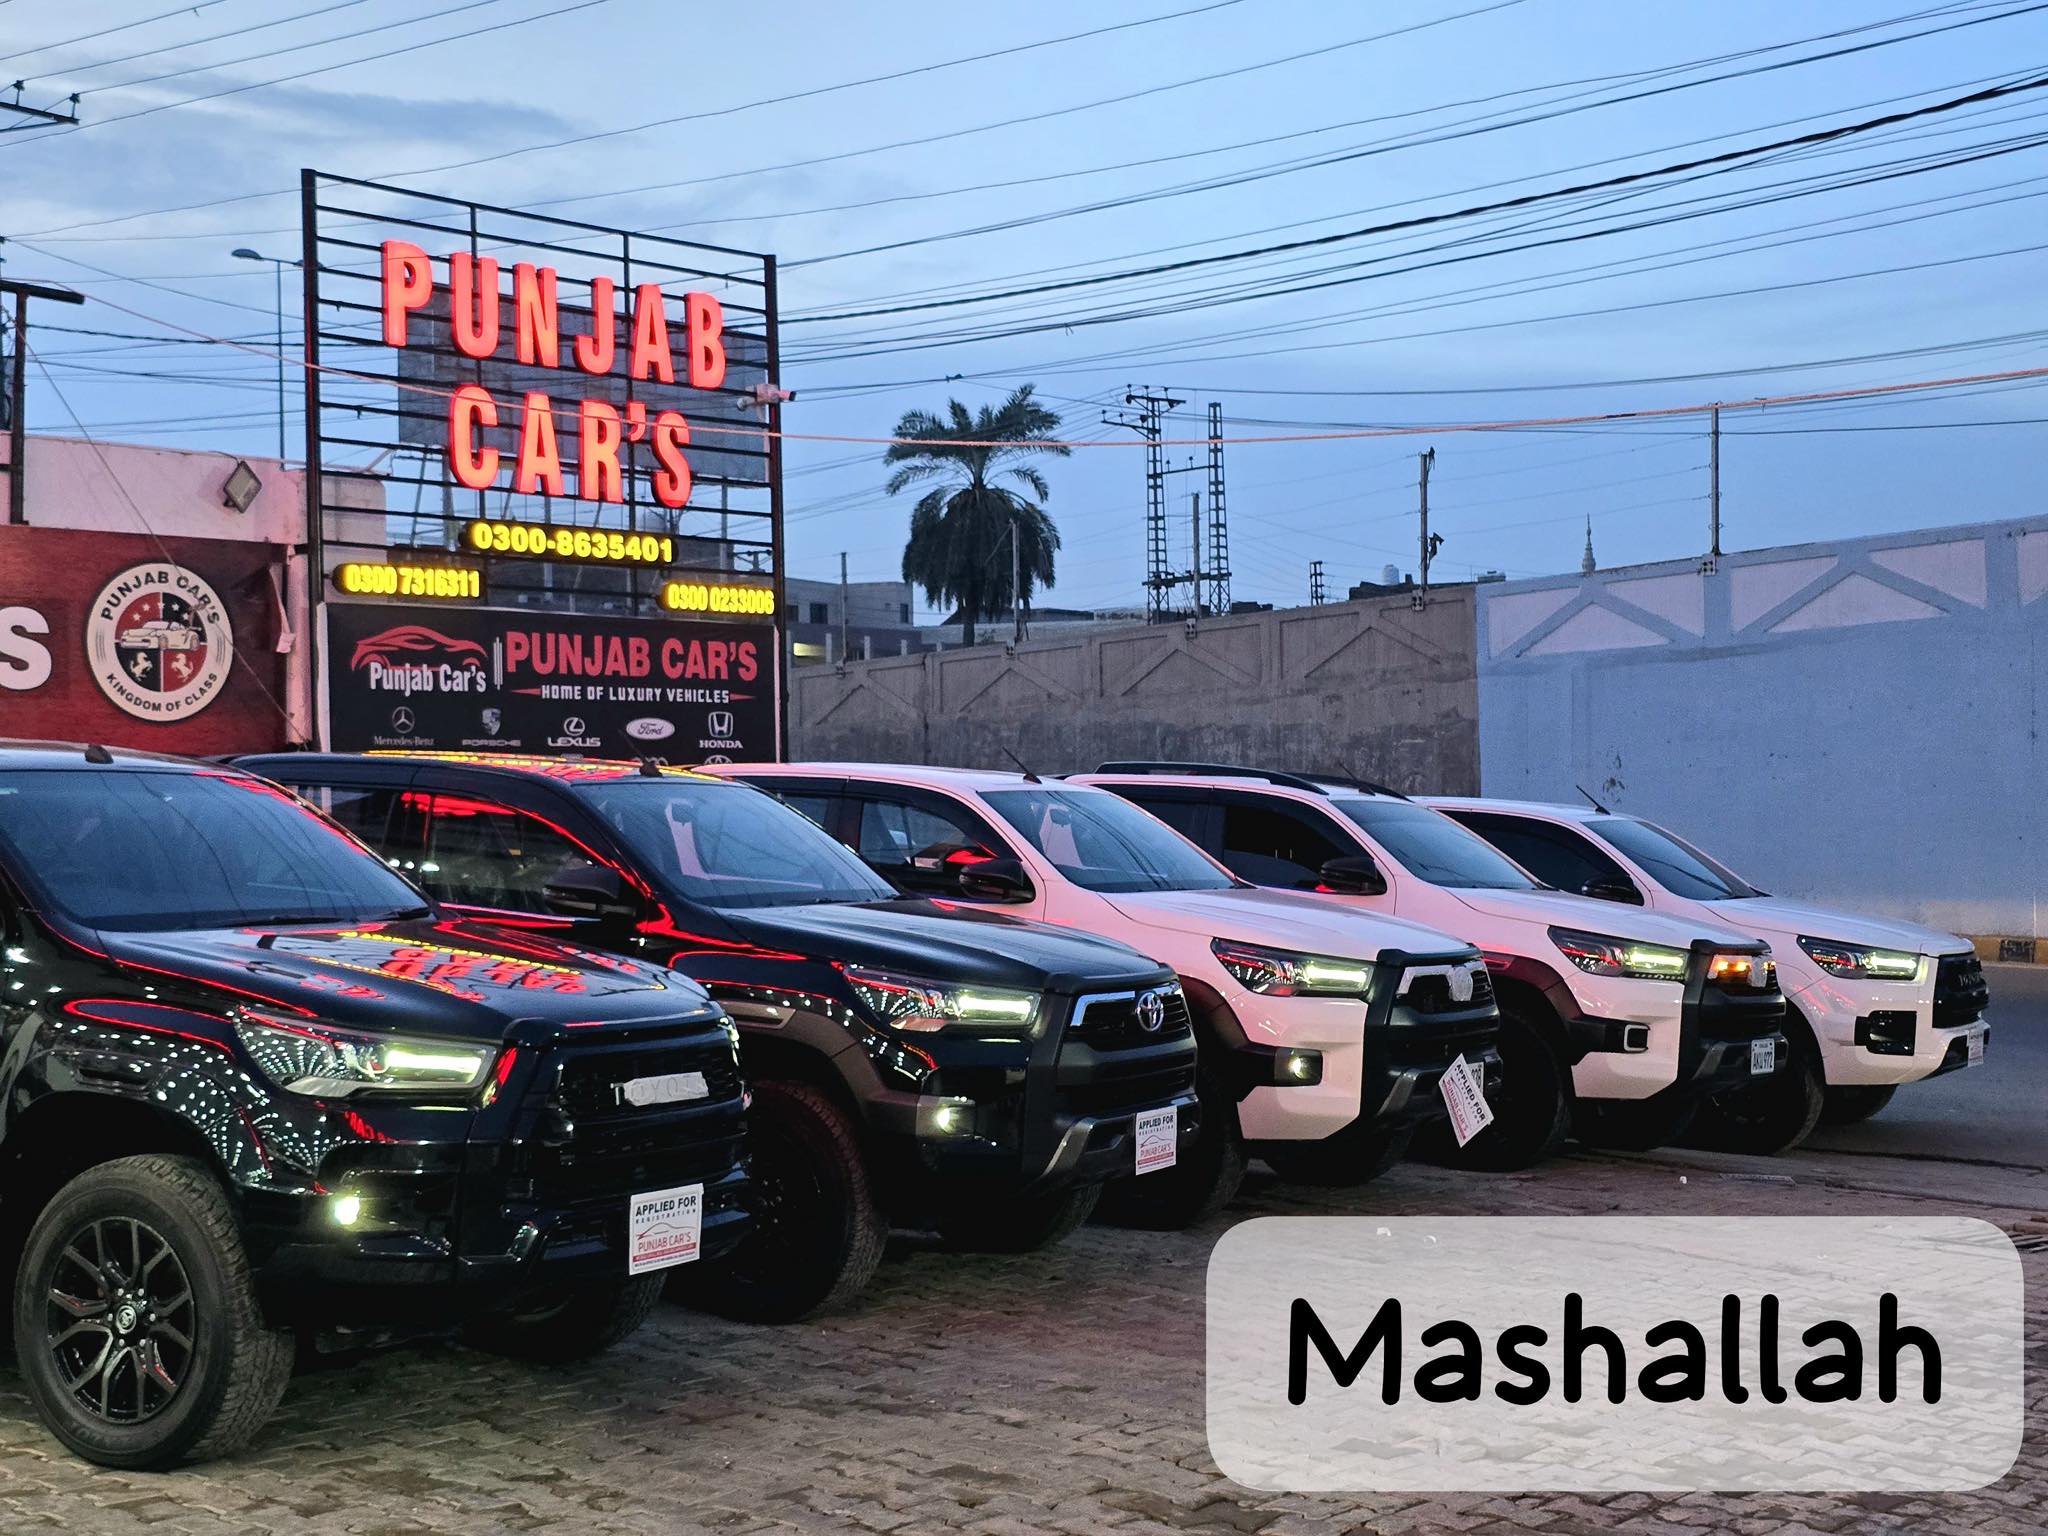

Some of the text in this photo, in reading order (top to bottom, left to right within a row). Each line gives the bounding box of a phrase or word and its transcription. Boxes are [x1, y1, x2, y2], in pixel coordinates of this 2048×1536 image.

[381, 240, 727, 389] PUNJAB
[449, 384, 692, 508] CAR'S
[473, 522, 672, 563] 0300-8635401
[345, 564, 398, 594] 0300
[101, 571, 221, 624] PUNJAB CAR'S
[668, 583, 708, 611] 0300
[506, 631, 758, 681] PUNJAB CAR'S
[106, 672, 218, 712] KINGDOM OF CLASS
[369, 661, 487, 697] Punjab Car's
[541, 685, 730, 704] HOME OF LUXURY VEHICLES
[374, 735, 435, 746] Mercedes-Benz
[462, 738, 522, 747] PORSCHE
[547, 737, 601, 747] LEXUS
[637, 722, 664, 735] Ford
[699, 739, 744, 749] HONDA
[1456, 1063, 1476, 1101] APPLIED
[1473, 1101, 1486, 1121] FOR
[1138, 1115, 1174, 1130] APPLIED FOR
[635, 1195, 697, 1217] APPLIED FOR
[638, 1231, 692, 1252] PUNJAB CAR'S
